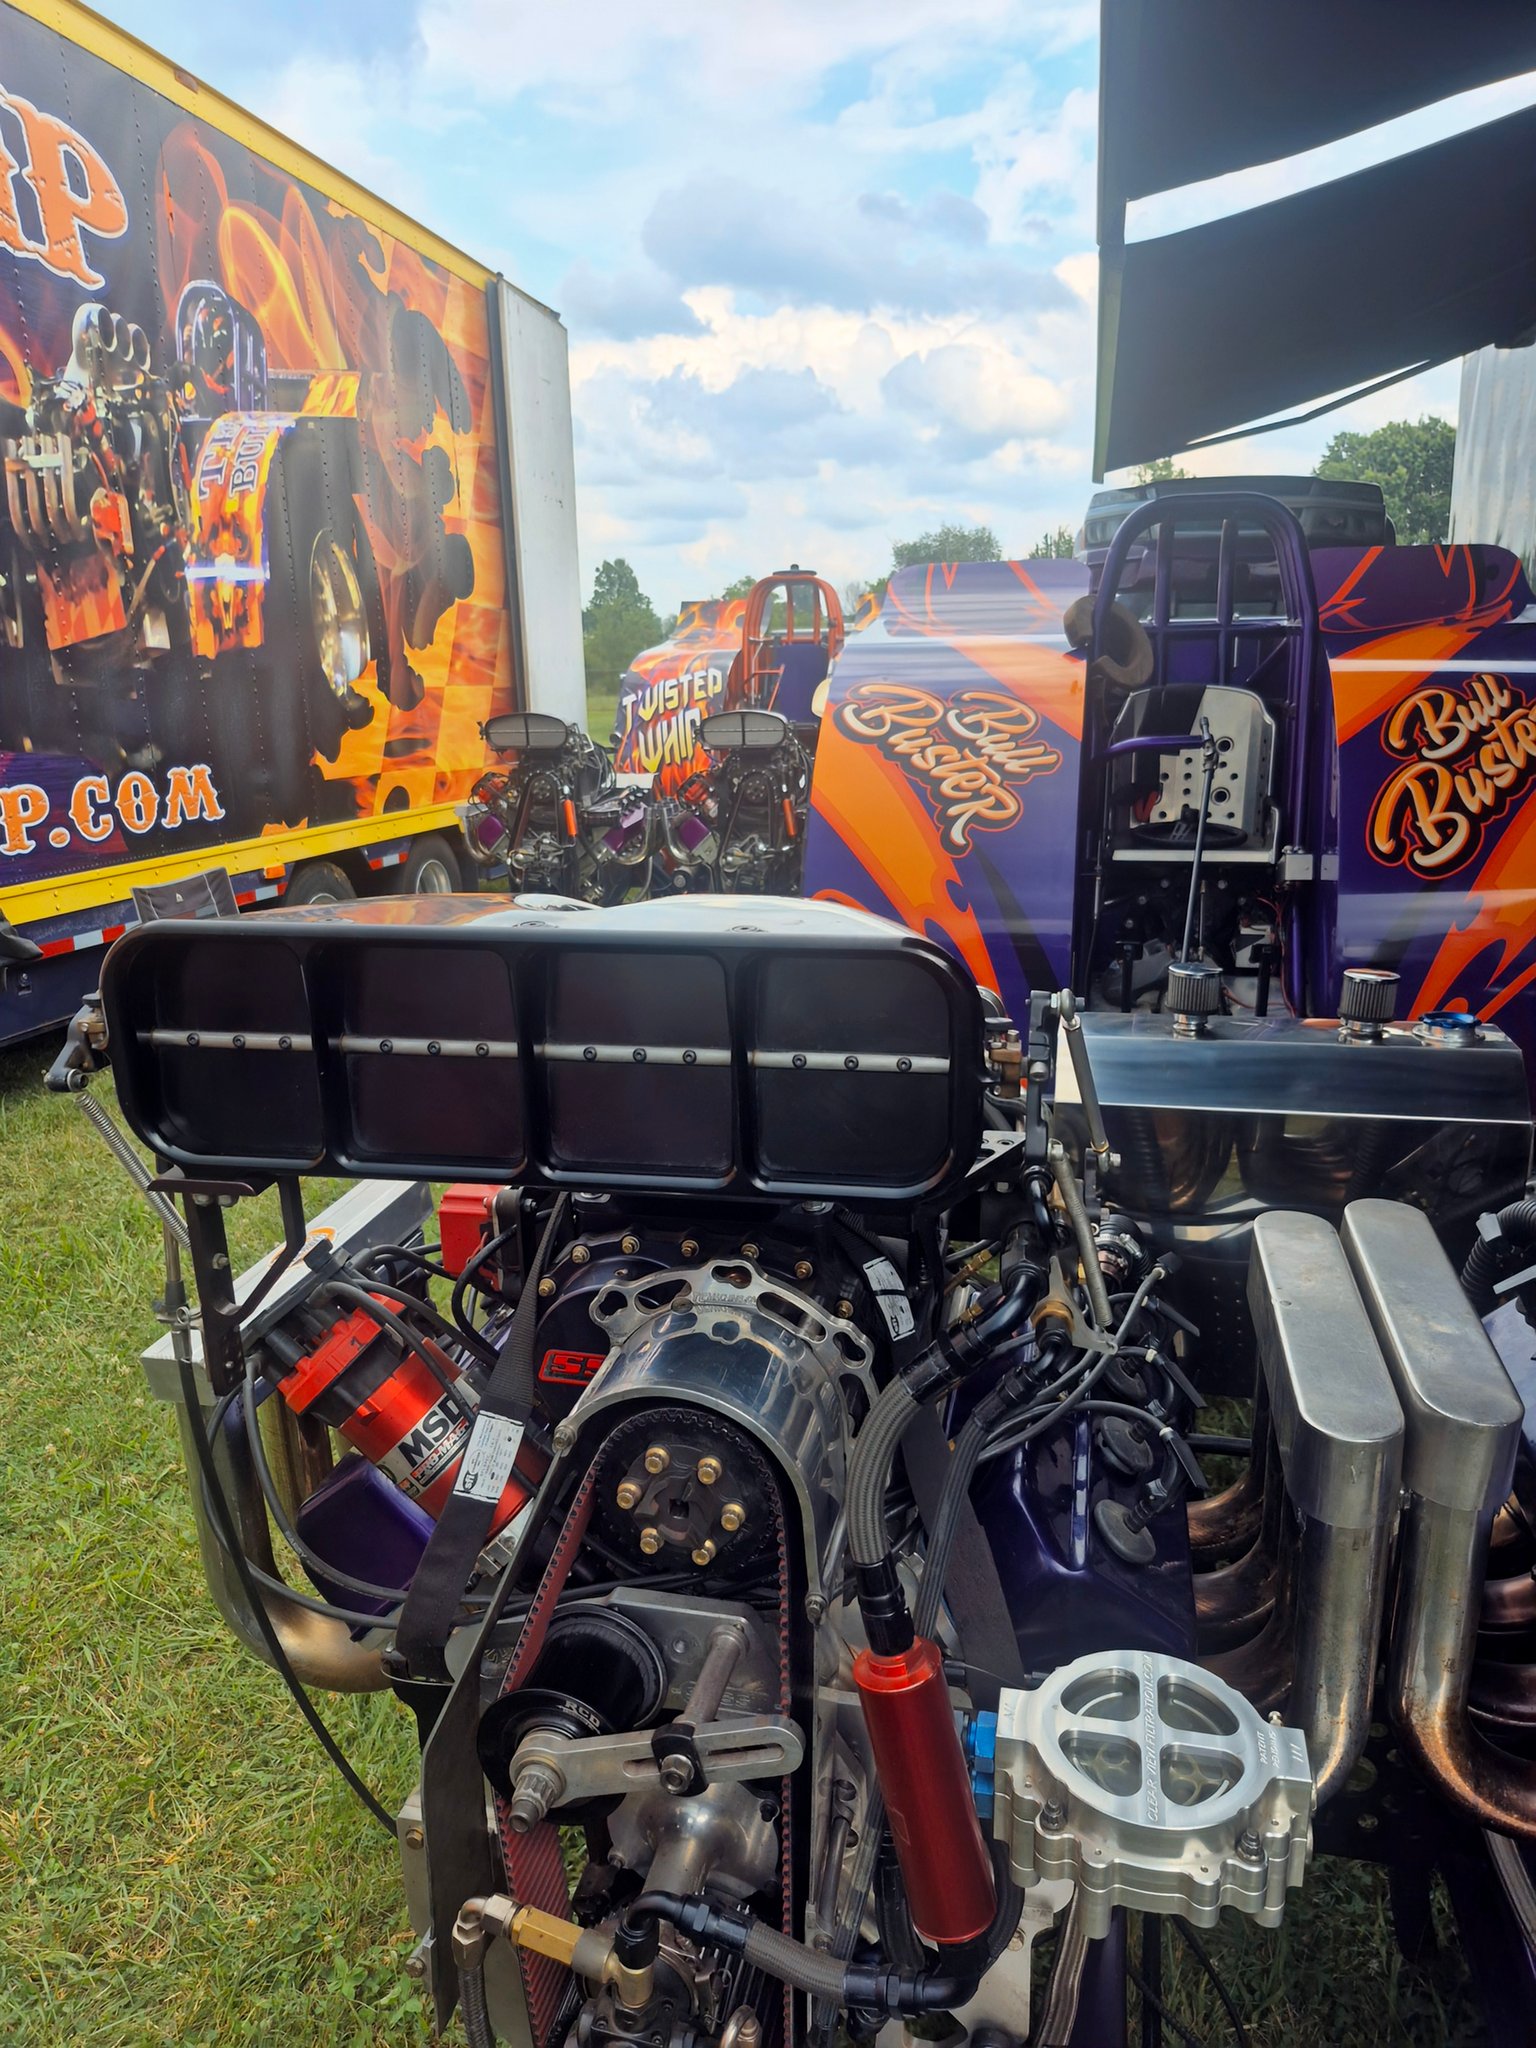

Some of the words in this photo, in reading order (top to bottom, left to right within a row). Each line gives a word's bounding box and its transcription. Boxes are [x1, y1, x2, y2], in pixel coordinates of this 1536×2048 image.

[622, 668, 723, 736] TWISTED
[944, 690, 1060, 775] Bull
[1387, 673, 1513, 761] Bull
[1373, 702, 1536, 868] Buste
[397, 1398, 465, 1469] MSD
[564, 1700, 600, 1728] RCD
